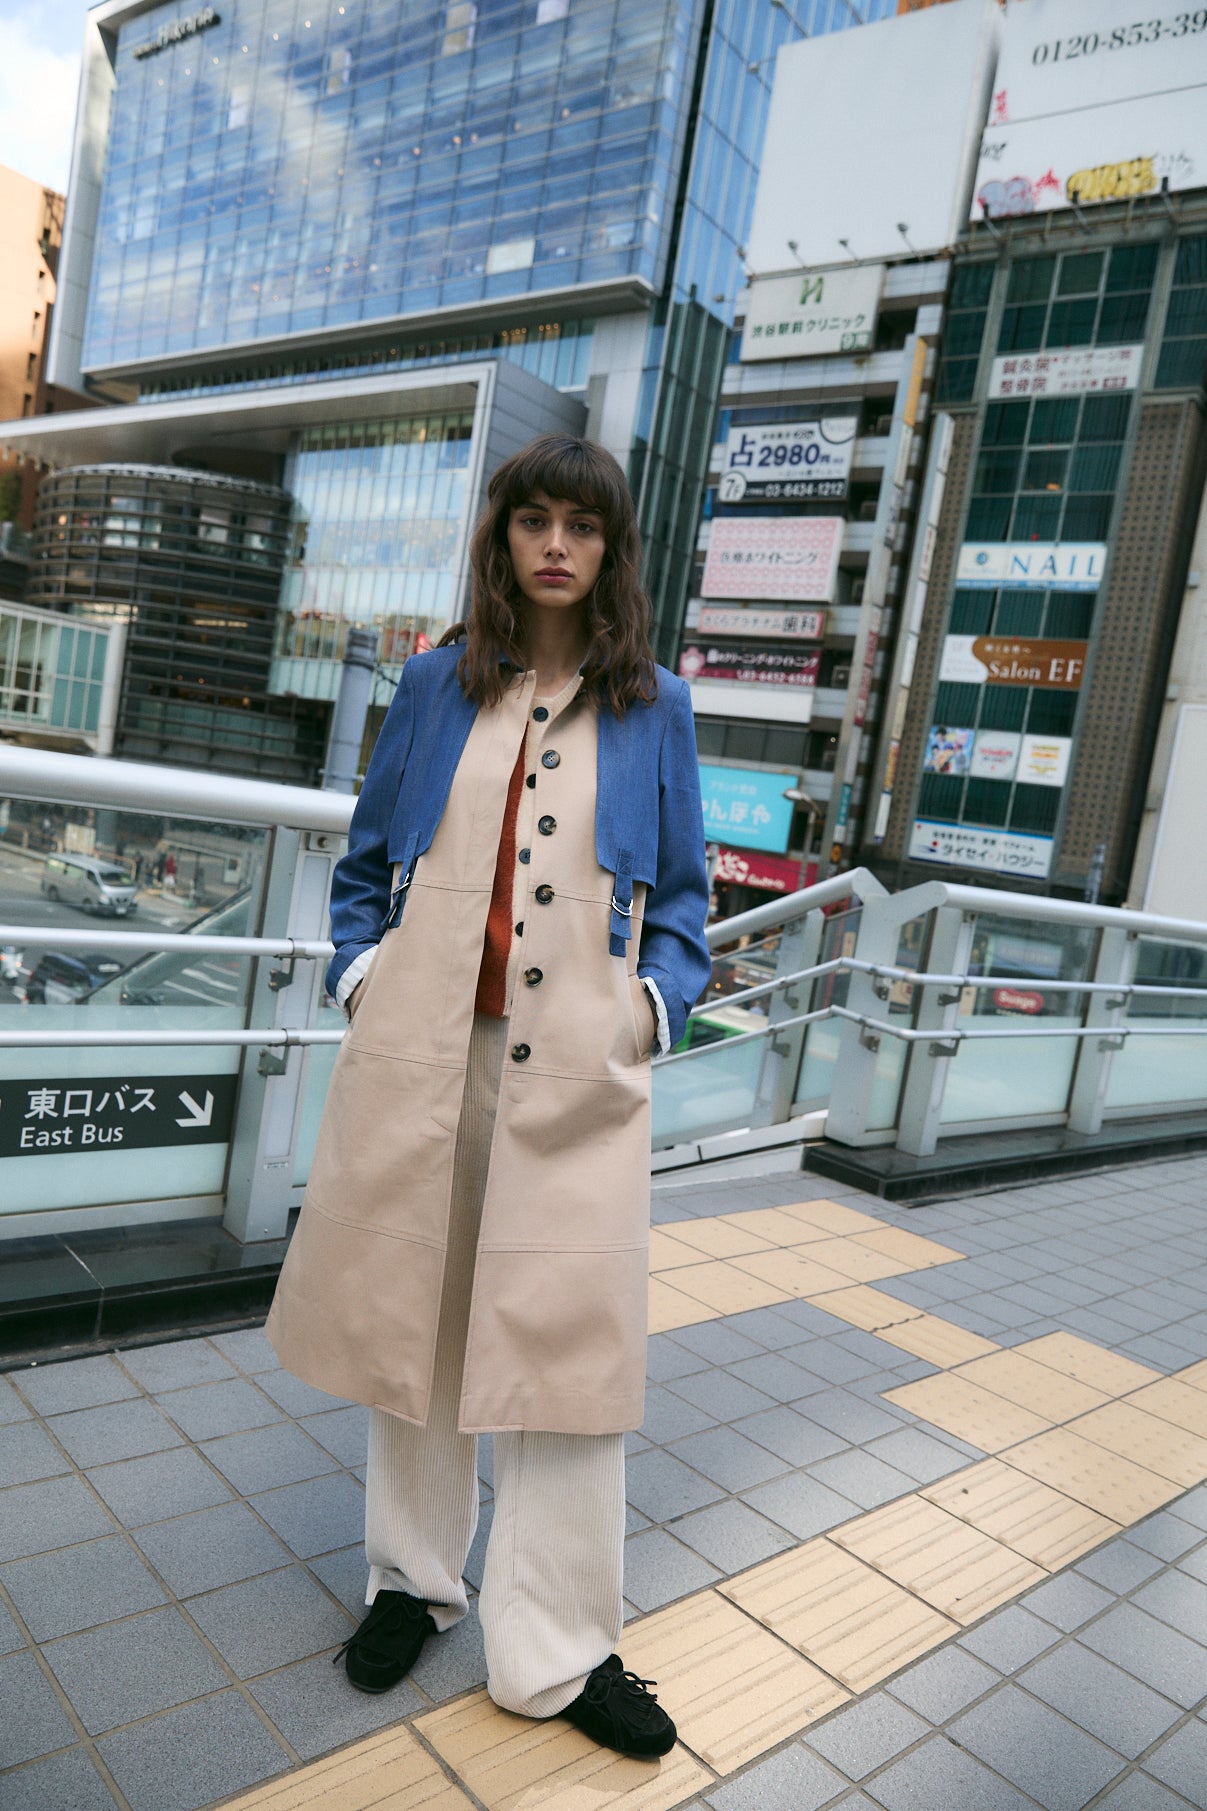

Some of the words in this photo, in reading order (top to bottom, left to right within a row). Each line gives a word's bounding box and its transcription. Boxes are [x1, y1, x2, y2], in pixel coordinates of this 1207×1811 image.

[1009, 554, 1101, 577] NAIL
[988, 659, 1041, 681] Salon
[1049, 657, 1083, 682] EF
[24, 1084, 157, 1119] 東口バス
[20, 1126, 73, 1148] East
[81, 1124, 124, 1144] Bus
